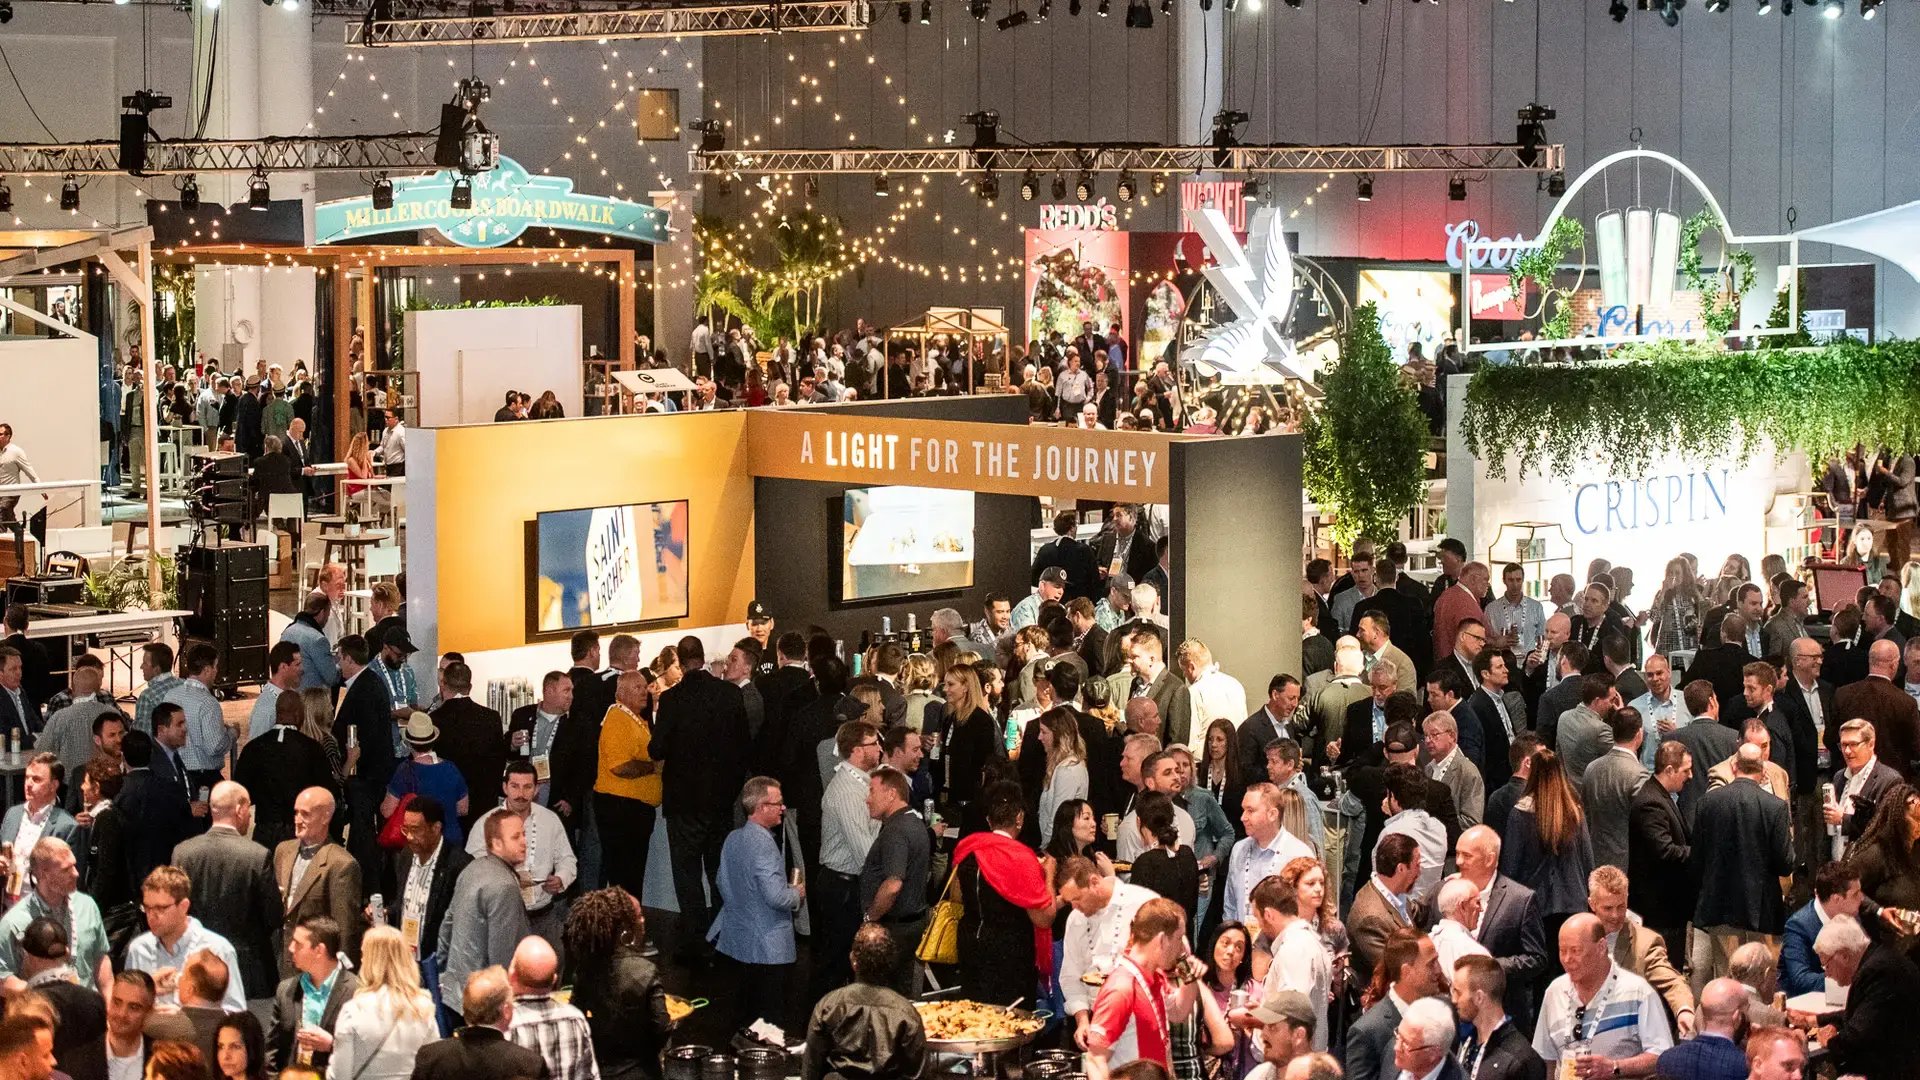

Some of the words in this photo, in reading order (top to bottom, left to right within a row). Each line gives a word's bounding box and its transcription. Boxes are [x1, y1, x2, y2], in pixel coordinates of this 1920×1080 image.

[496, 198, 615, 225] BOARDWALK
[1040, 197, 1117, 231] REDD'S
[1445, 220, 1546, 270] Coor
[800, 431, 814, 464] A
[826, 431, 899, 470] LIGHT
[910, 437, 959, 474] FOR
[972, 441, 1020, 478] THE
[1032, 445, 1157, 487] JOURNEY
[1575, 469, 1729, 534] CRISPIN
[593, 505, 626, 581] SAINT
[596, 547, 630, 612] ARCHER
